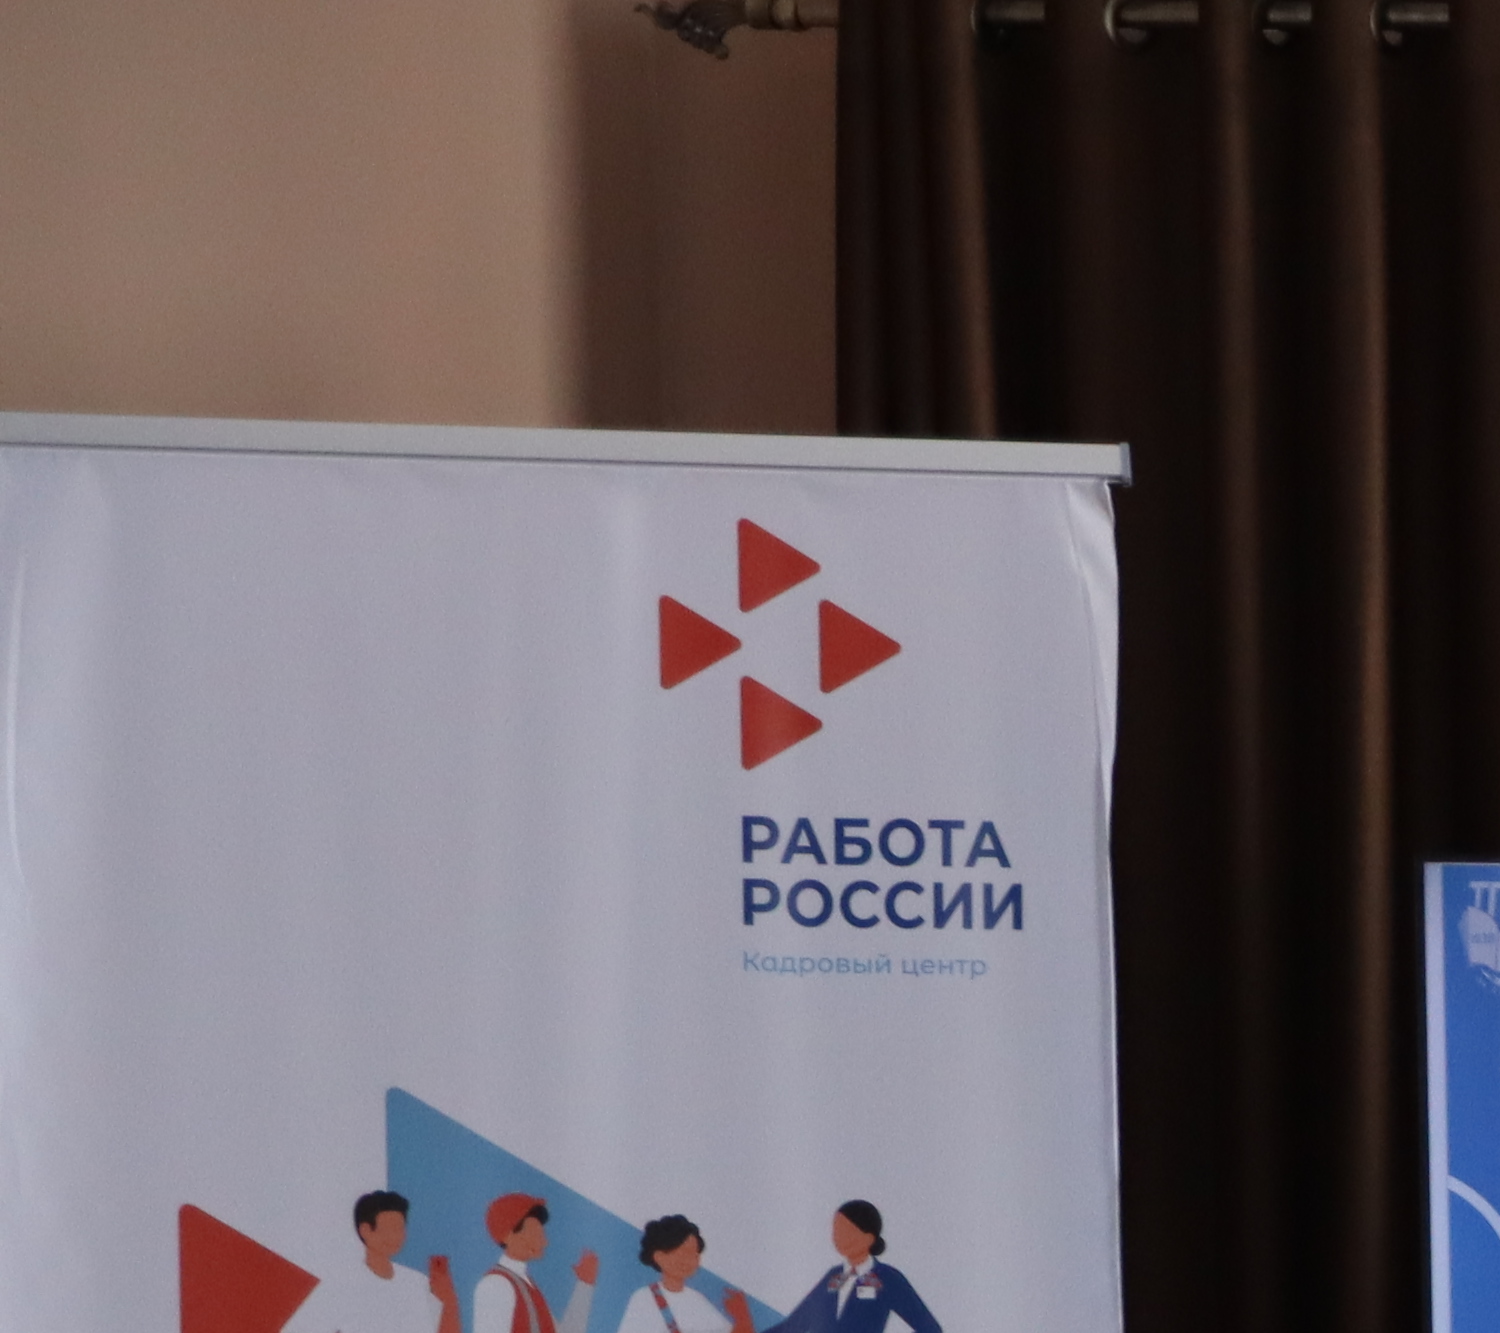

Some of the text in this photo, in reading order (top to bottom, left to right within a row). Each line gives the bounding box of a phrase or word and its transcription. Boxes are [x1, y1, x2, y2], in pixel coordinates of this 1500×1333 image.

[742, 815, 1012, 868] РАБОТА
[743, 878, 1023, 930] РОССИИ
[743, 951, 988, 980] Кадровый центр
